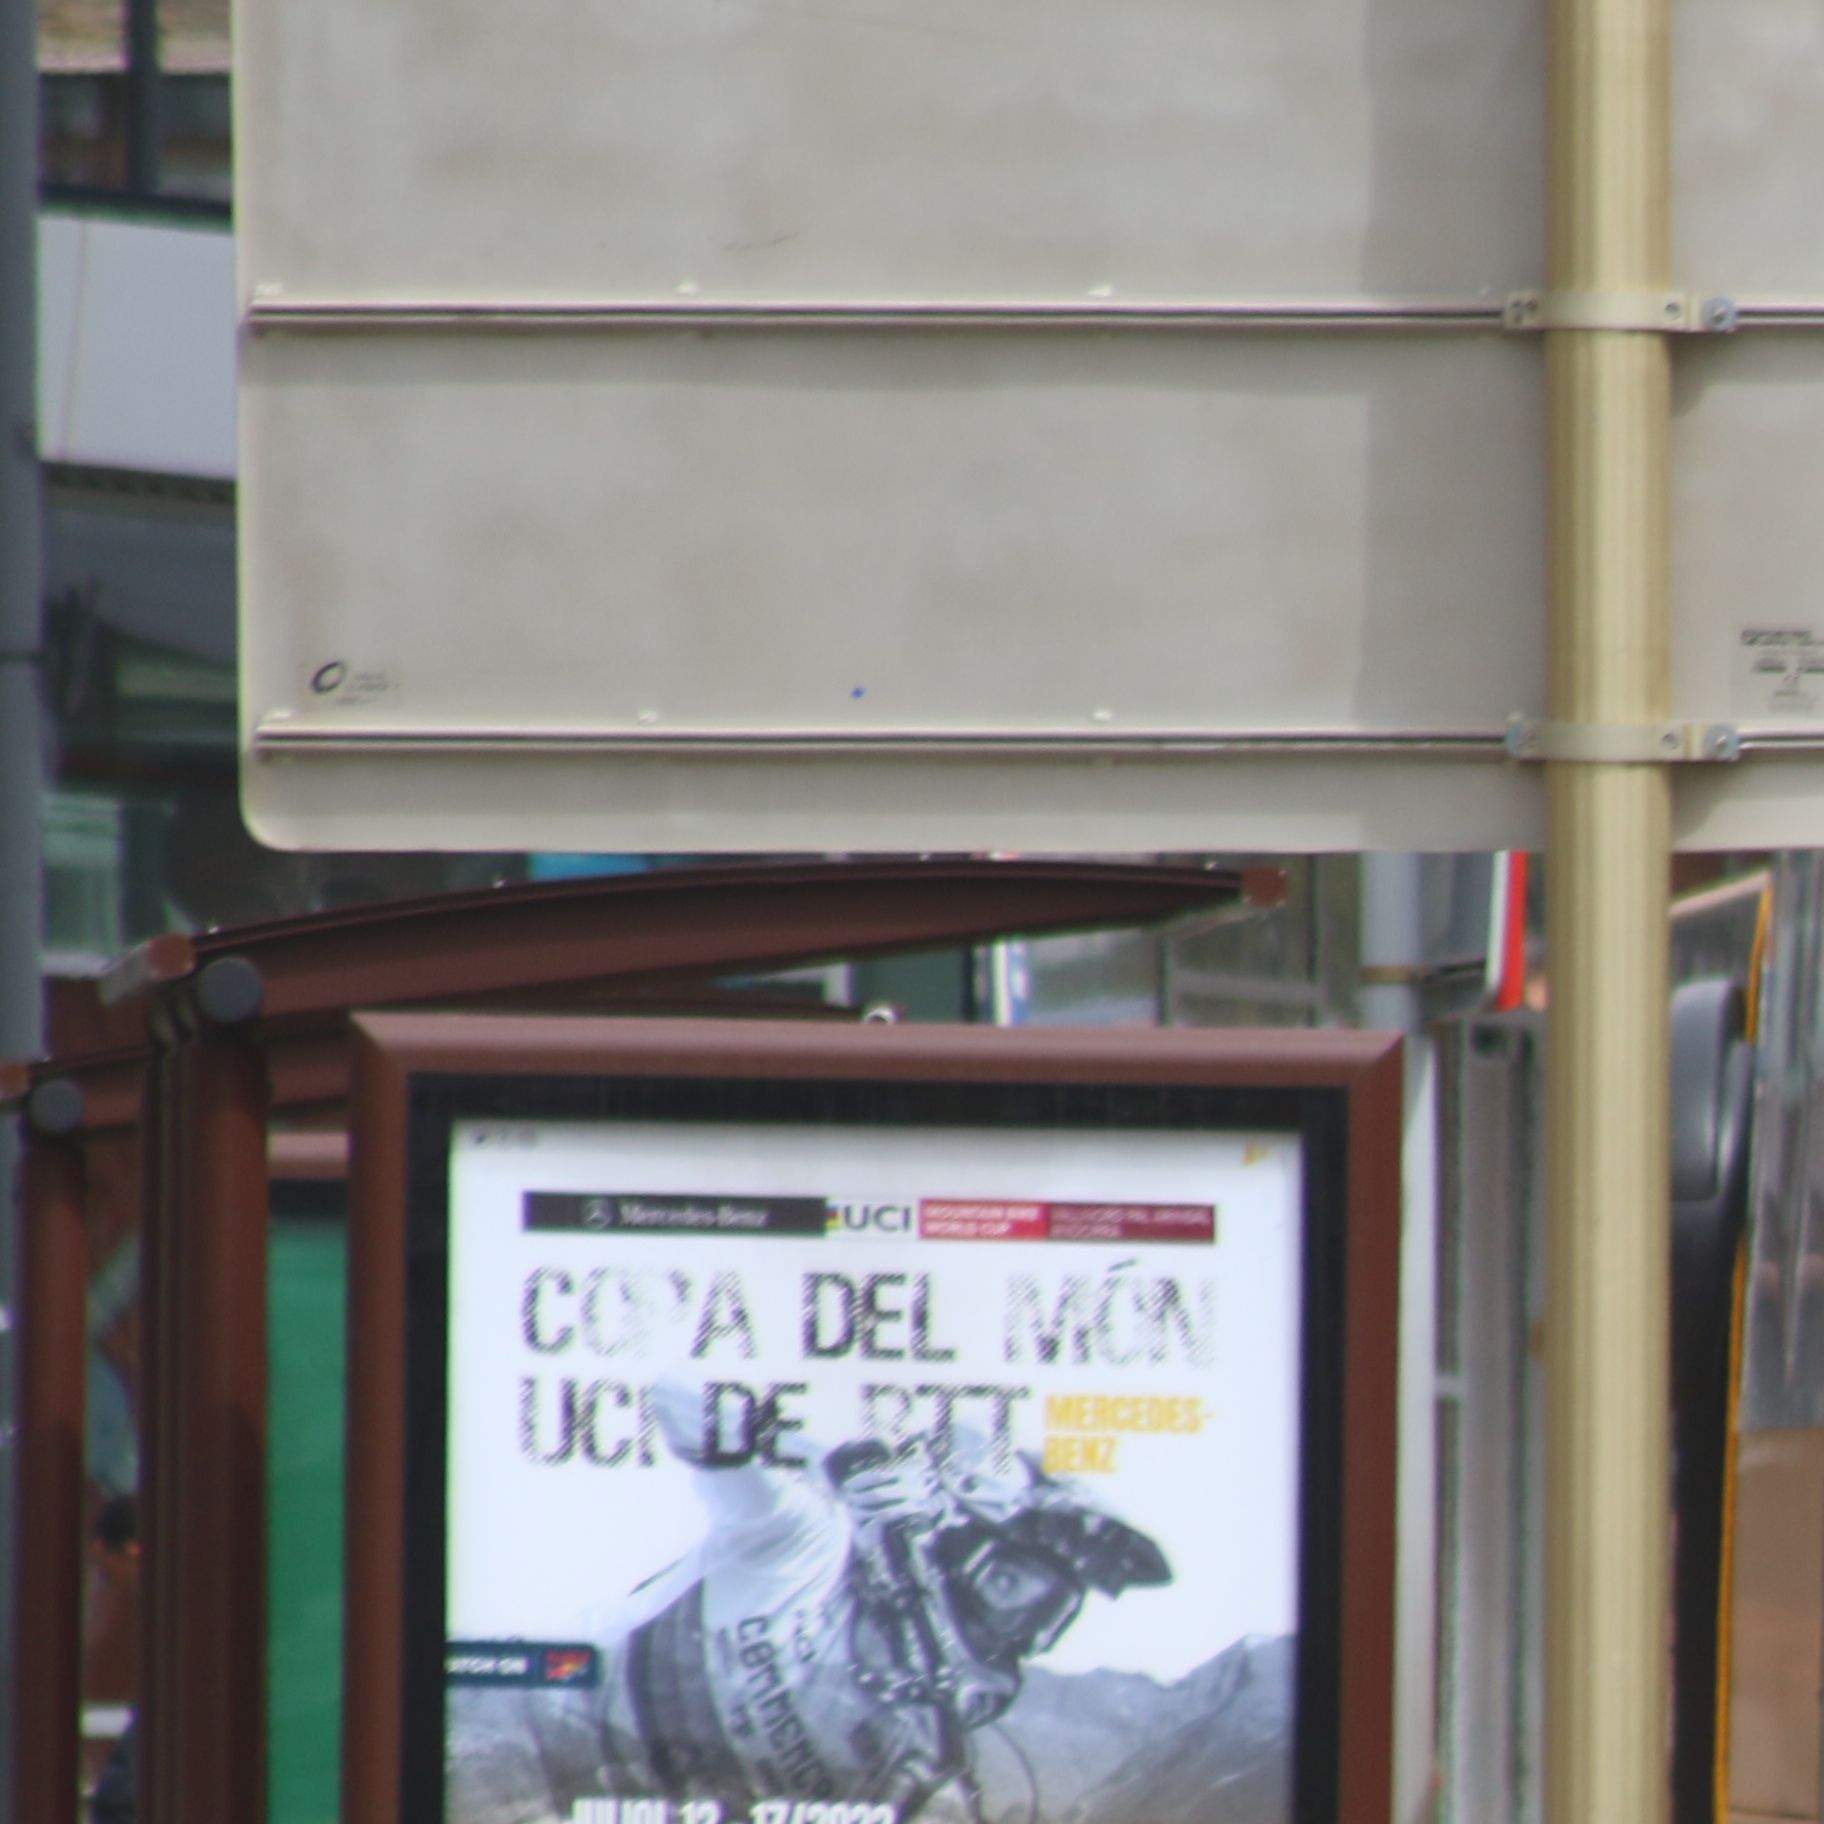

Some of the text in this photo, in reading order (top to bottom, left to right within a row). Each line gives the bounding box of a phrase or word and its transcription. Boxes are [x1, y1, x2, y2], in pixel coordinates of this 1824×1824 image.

[845, 1204, 912, 1233] UCI
[801, 1272, 957, 1362] DEL
[1002, 1258, 1218, 1367] MÓN
[702, 1381, 810, 1469] DE
[1043, 1393, 1217, 1434] MERCEDES-
[1043, 1434, 1117, 1474] BENZ
